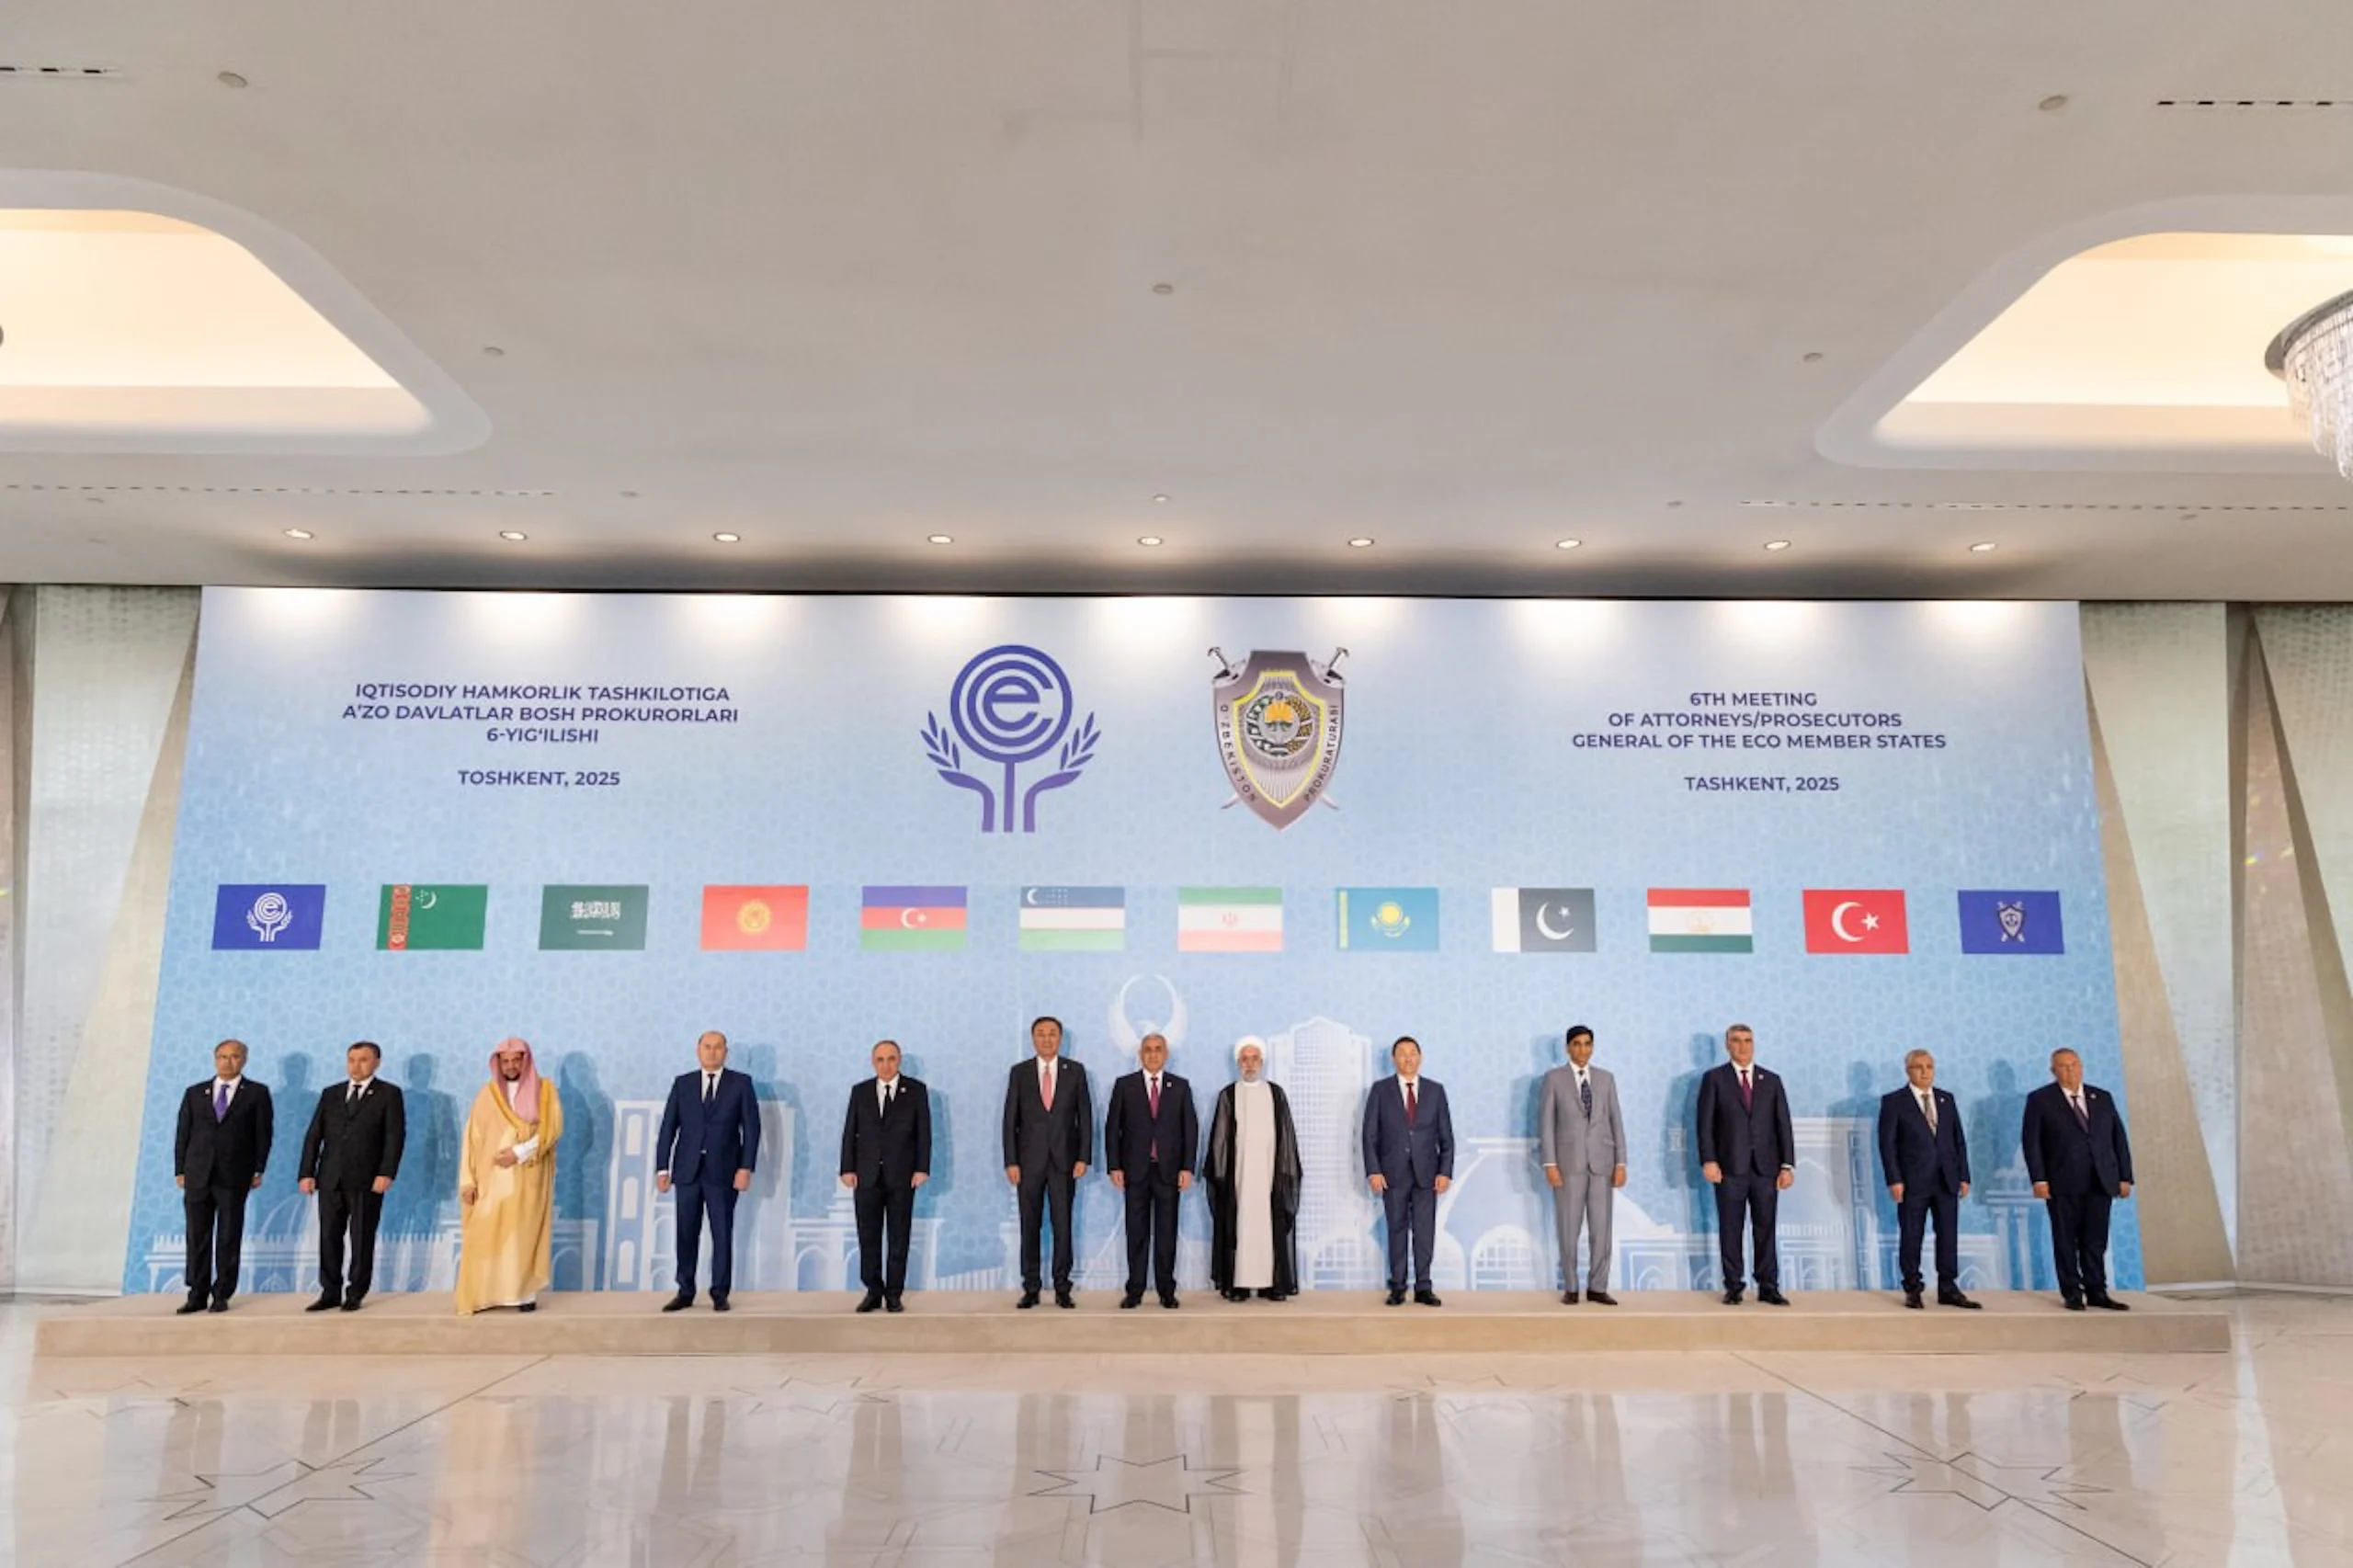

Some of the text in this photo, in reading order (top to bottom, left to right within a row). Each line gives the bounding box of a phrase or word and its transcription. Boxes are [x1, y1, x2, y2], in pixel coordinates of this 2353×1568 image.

[356, 683, 731, 702] IQTISODIY HAMKORLIK TASHKILOTIGA
[1689, 692, 1818, 707] 6TH MEETING
[394, 705, 514, 722] DAVLATLAR
[519, 707, 575, 722] BOSH
[581, 707, 739, 723] PROKURORLARI
[1608, 711, 1903, 729] OF ATTORNEYS/PROSECUTORS
[1572, 733, 1947, 749] GENERAL OF THE ECO MEMBER STATES
[457, 769, 620, 788] TOSHKENT, 2025
[1683, 776, 1840, 793] TASHKENT, 2025
